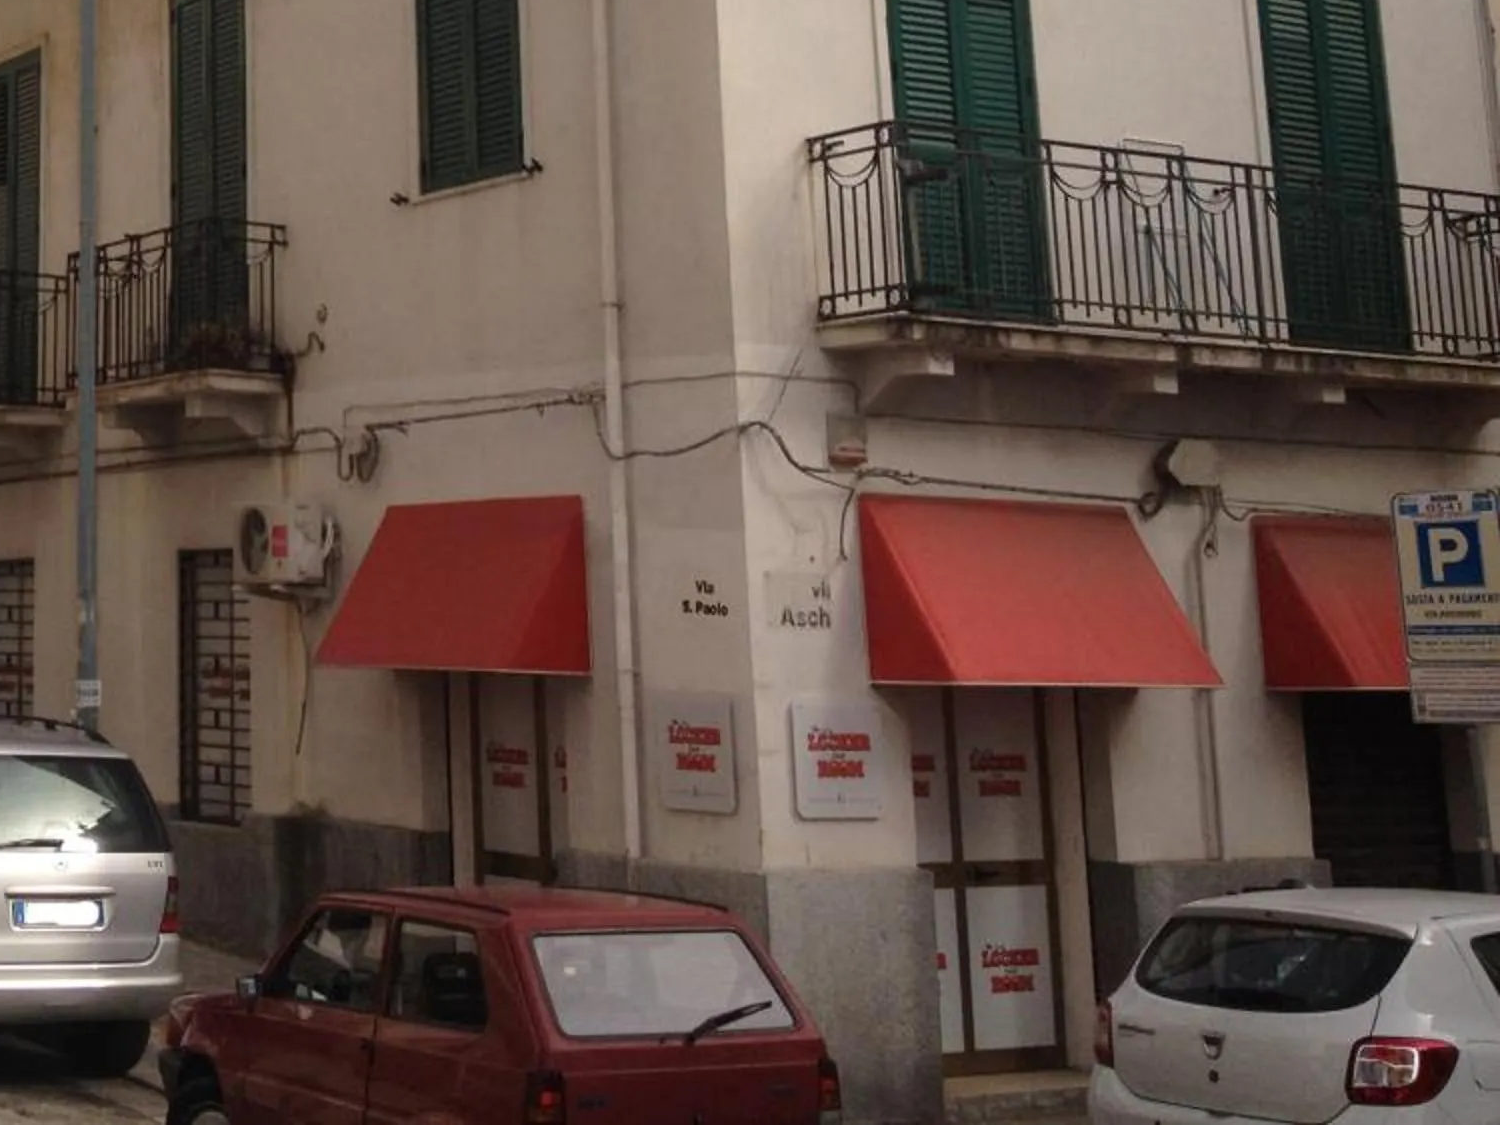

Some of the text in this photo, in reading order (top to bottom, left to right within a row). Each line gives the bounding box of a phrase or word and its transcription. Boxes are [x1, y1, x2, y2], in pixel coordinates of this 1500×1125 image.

[1427, 526, 1469, 583] P
[695, 579, 715, 595] Via
[1406, 591, 1500, 605] SOSTA A PAGAMENT
[695, 600, 729, 617] Paolo
[780, 606, 831, 628] Asch
